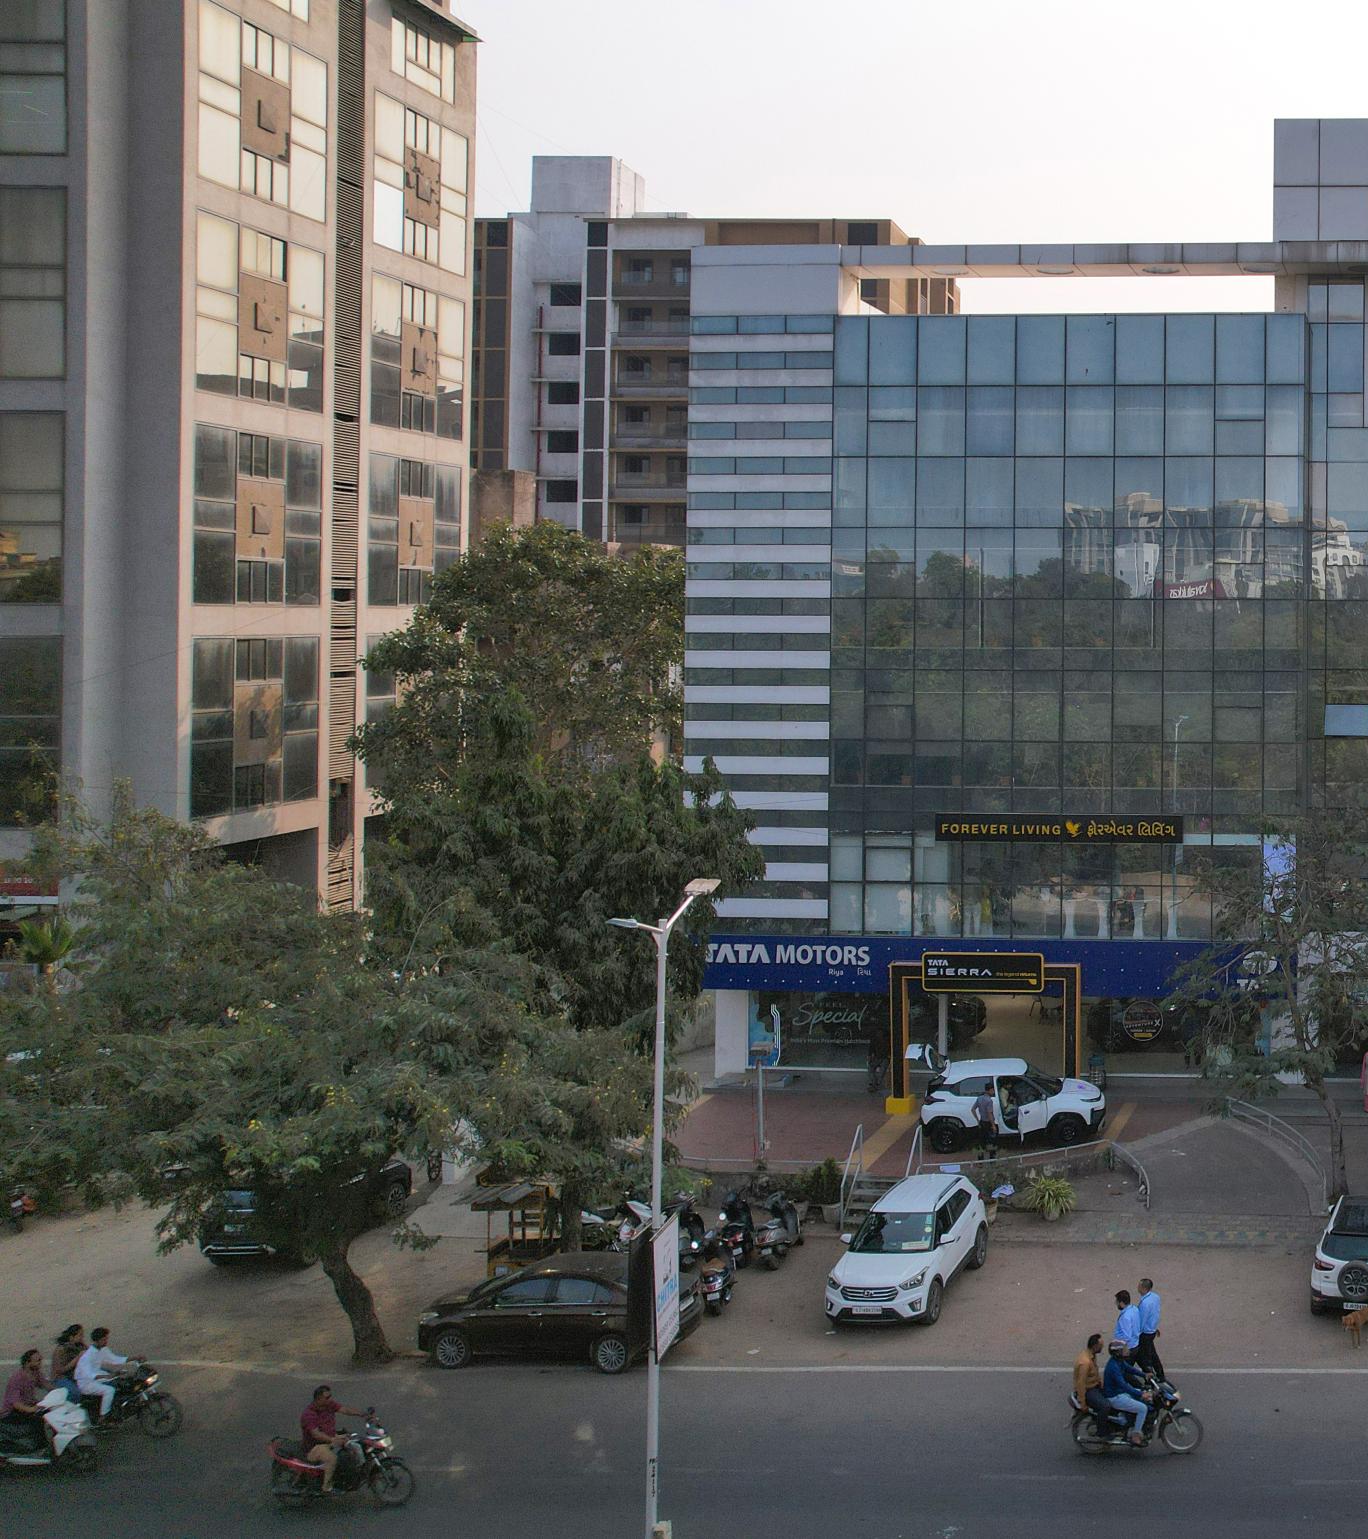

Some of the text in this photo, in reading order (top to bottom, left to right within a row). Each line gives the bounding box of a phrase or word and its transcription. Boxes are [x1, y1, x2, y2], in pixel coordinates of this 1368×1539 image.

[941, 823, 1061, 835] FOREVER LIVING
[1087, 820, 1133, 838] ફોરએવર
[706, 943, 870, 966] TATA MOTORS
[927, 959, 949, 967] TATA
[829, 968, 844, 977] Riya
[927, 968, 992, 976] SIERRA
[792, 1001, 868, 1036] Special
